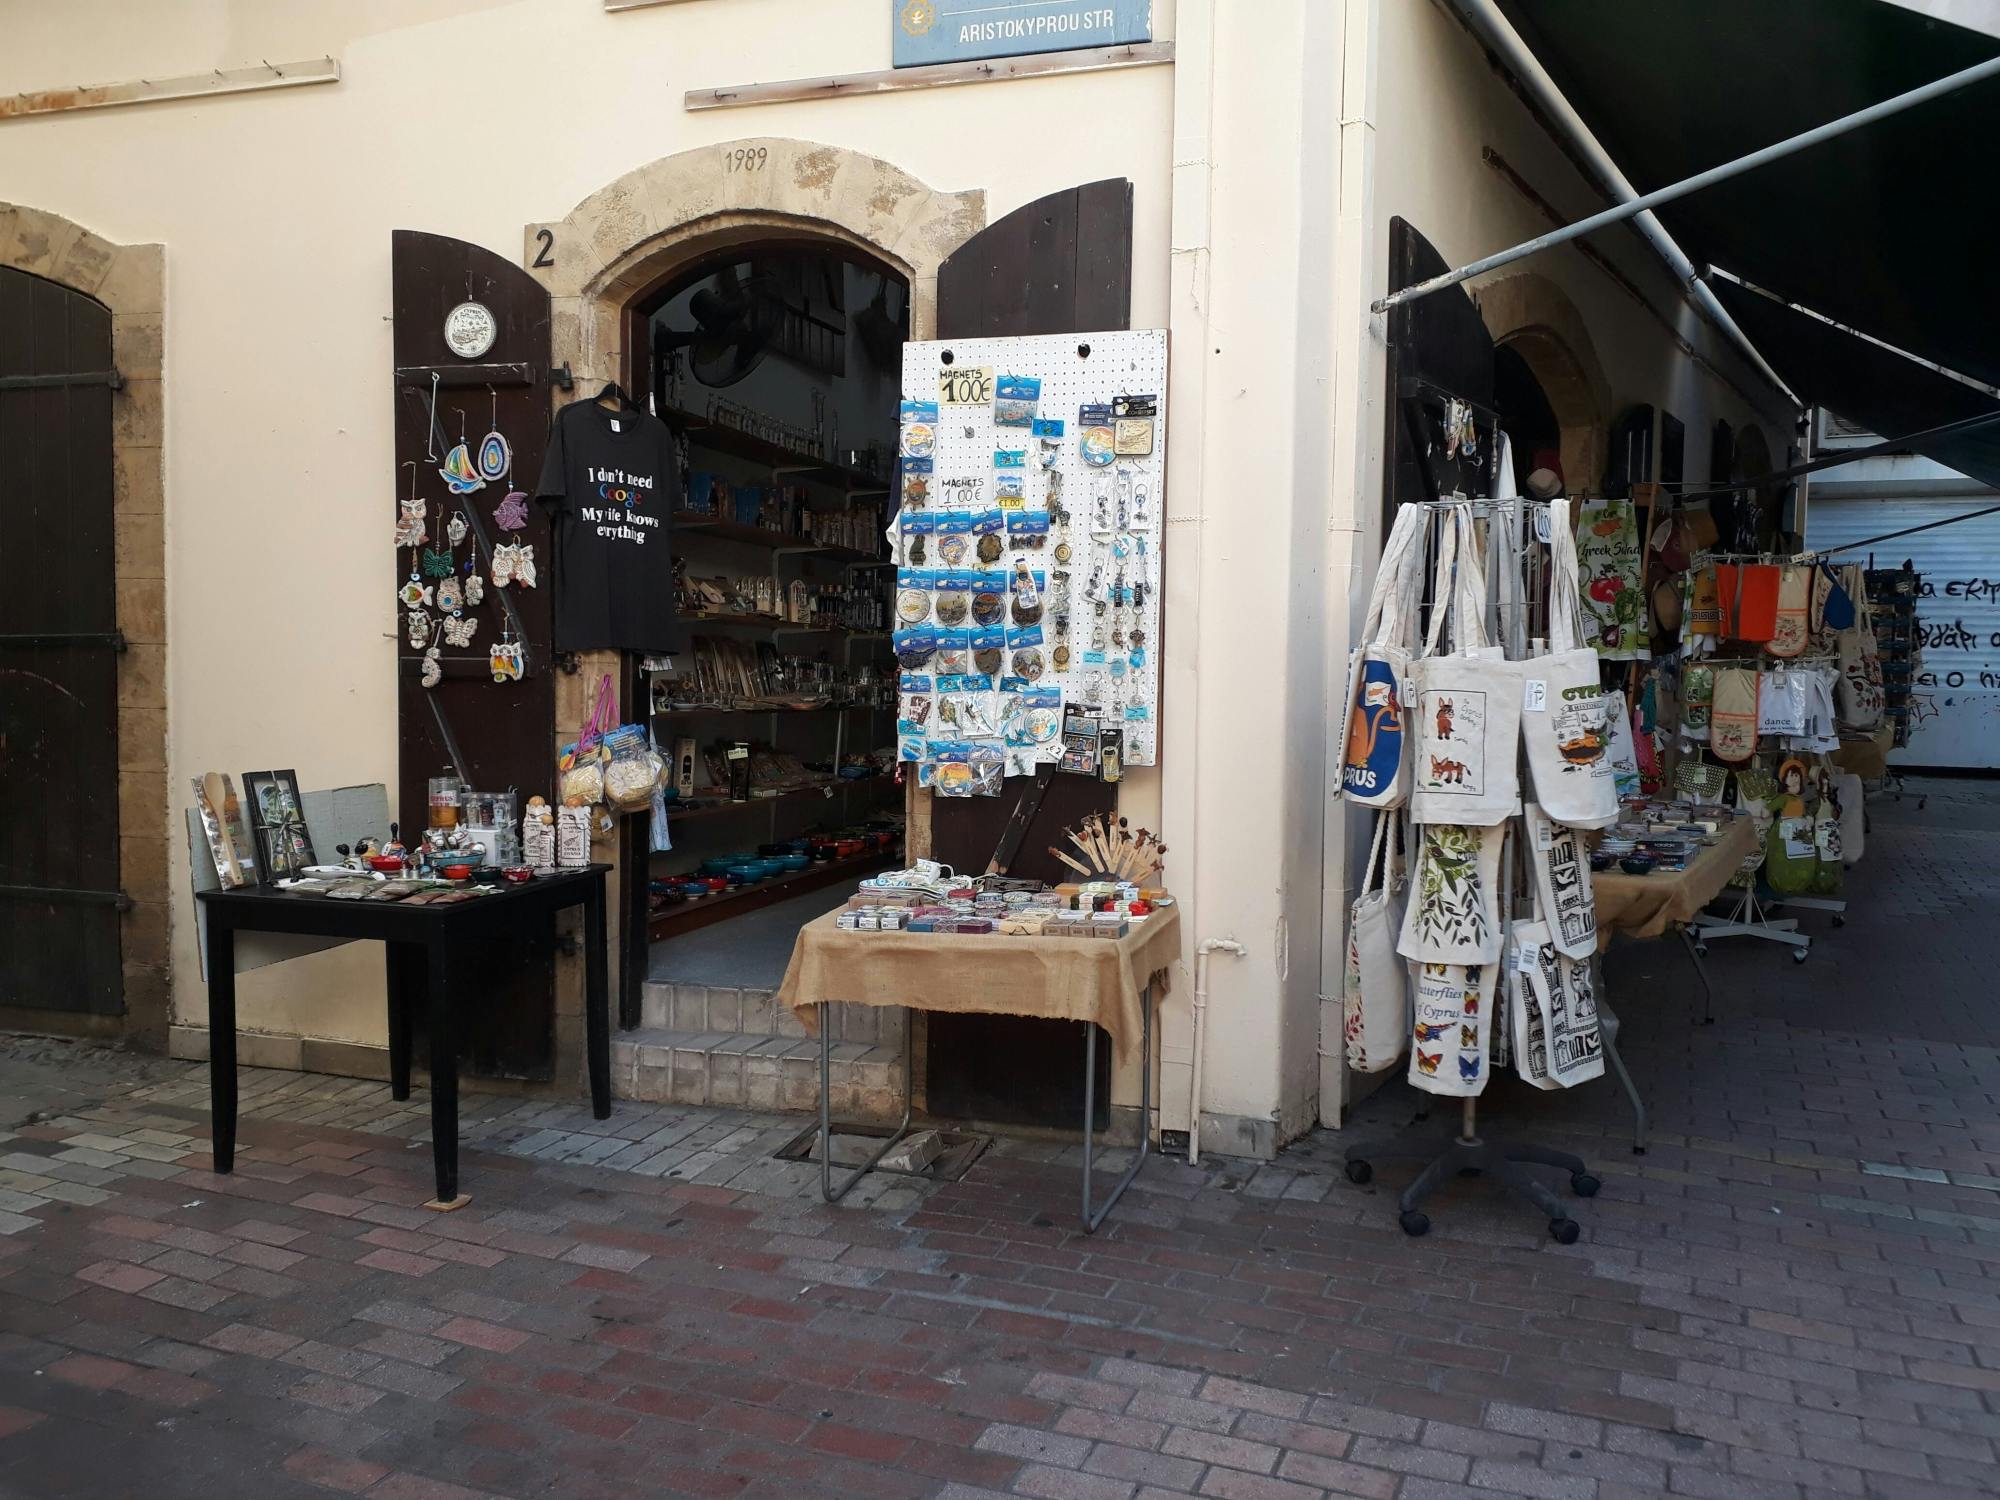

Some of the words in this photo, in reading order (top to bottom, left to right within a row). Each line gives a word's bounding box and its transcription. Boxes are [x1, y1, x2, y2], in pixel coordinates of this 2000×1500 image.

[959, 13, 1080, 43] ARISTOKYPROU
[1083, 9, 1114, 29] STR
[726, 147, 768, 174] 1989
[532, 229, 555, 268] 2
[940, 369, 983, 379] MAGNETS
[942, 378, 992, 403] 1.00€
[942, 478, 984, 488] MAGNETS
[581, 507, 603, 523] My
[1764, 717, 1791, 726] dance
[1344, 766, 1377, 789] PRUS
[1418, 986, 1462, 1001] utterflies
